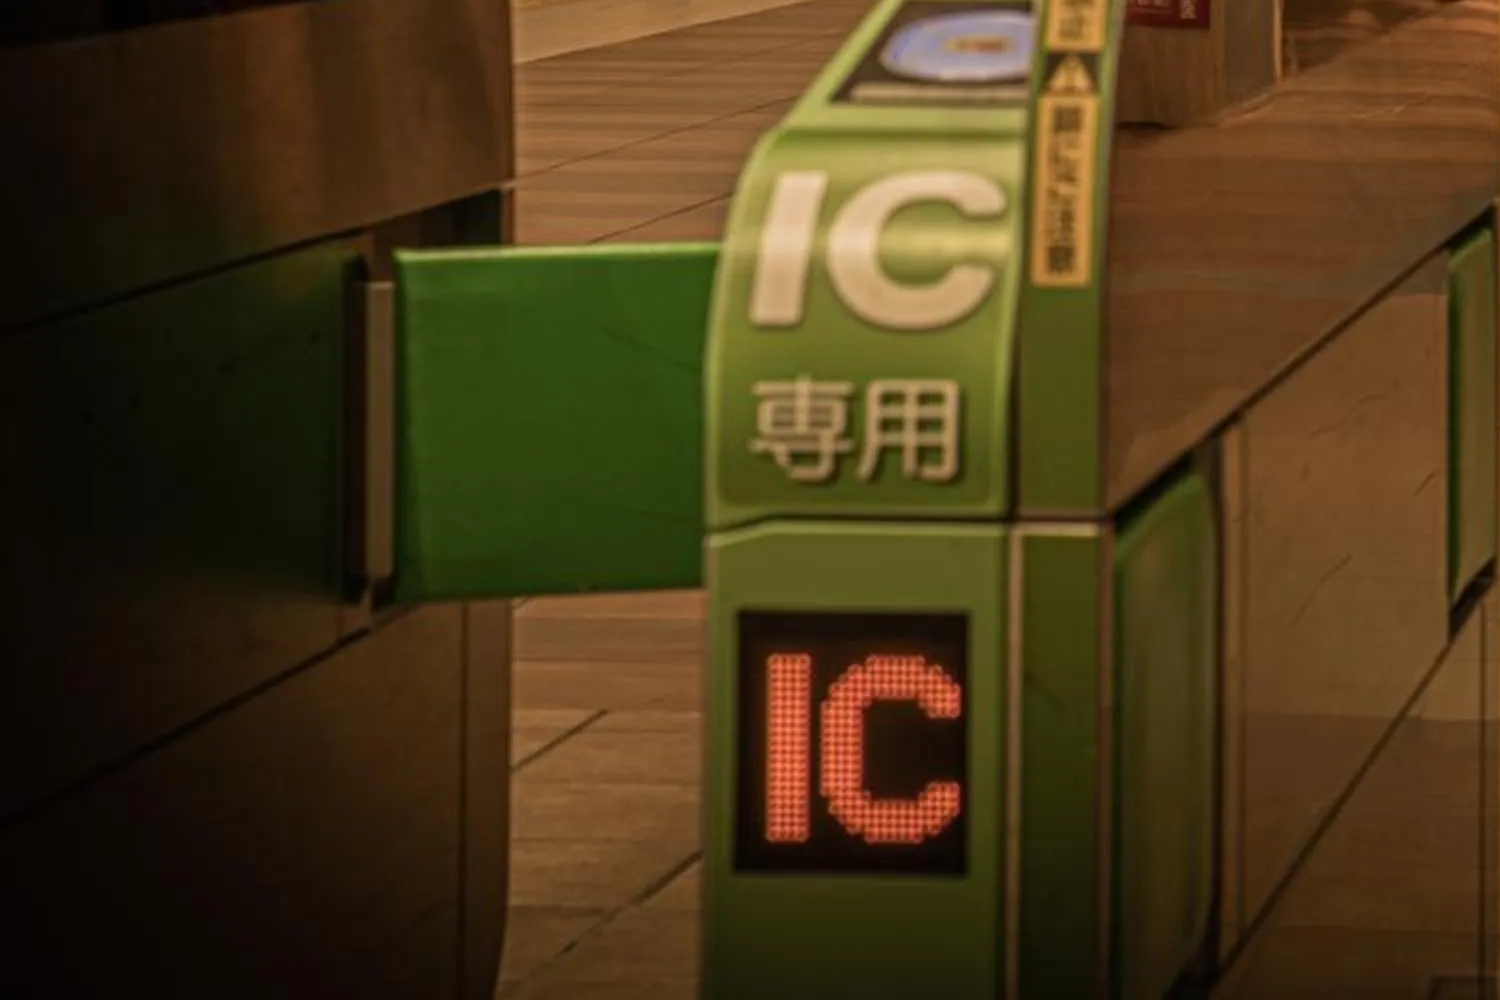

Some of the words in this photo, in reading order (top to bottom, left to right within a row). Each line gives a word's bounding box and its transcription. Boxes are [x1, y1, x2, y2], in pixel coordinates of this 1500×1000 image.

[749, 170, 1007, 331] IC
[749, 374, 960, 482] 専用
[765, 652, 962, 844] IC
